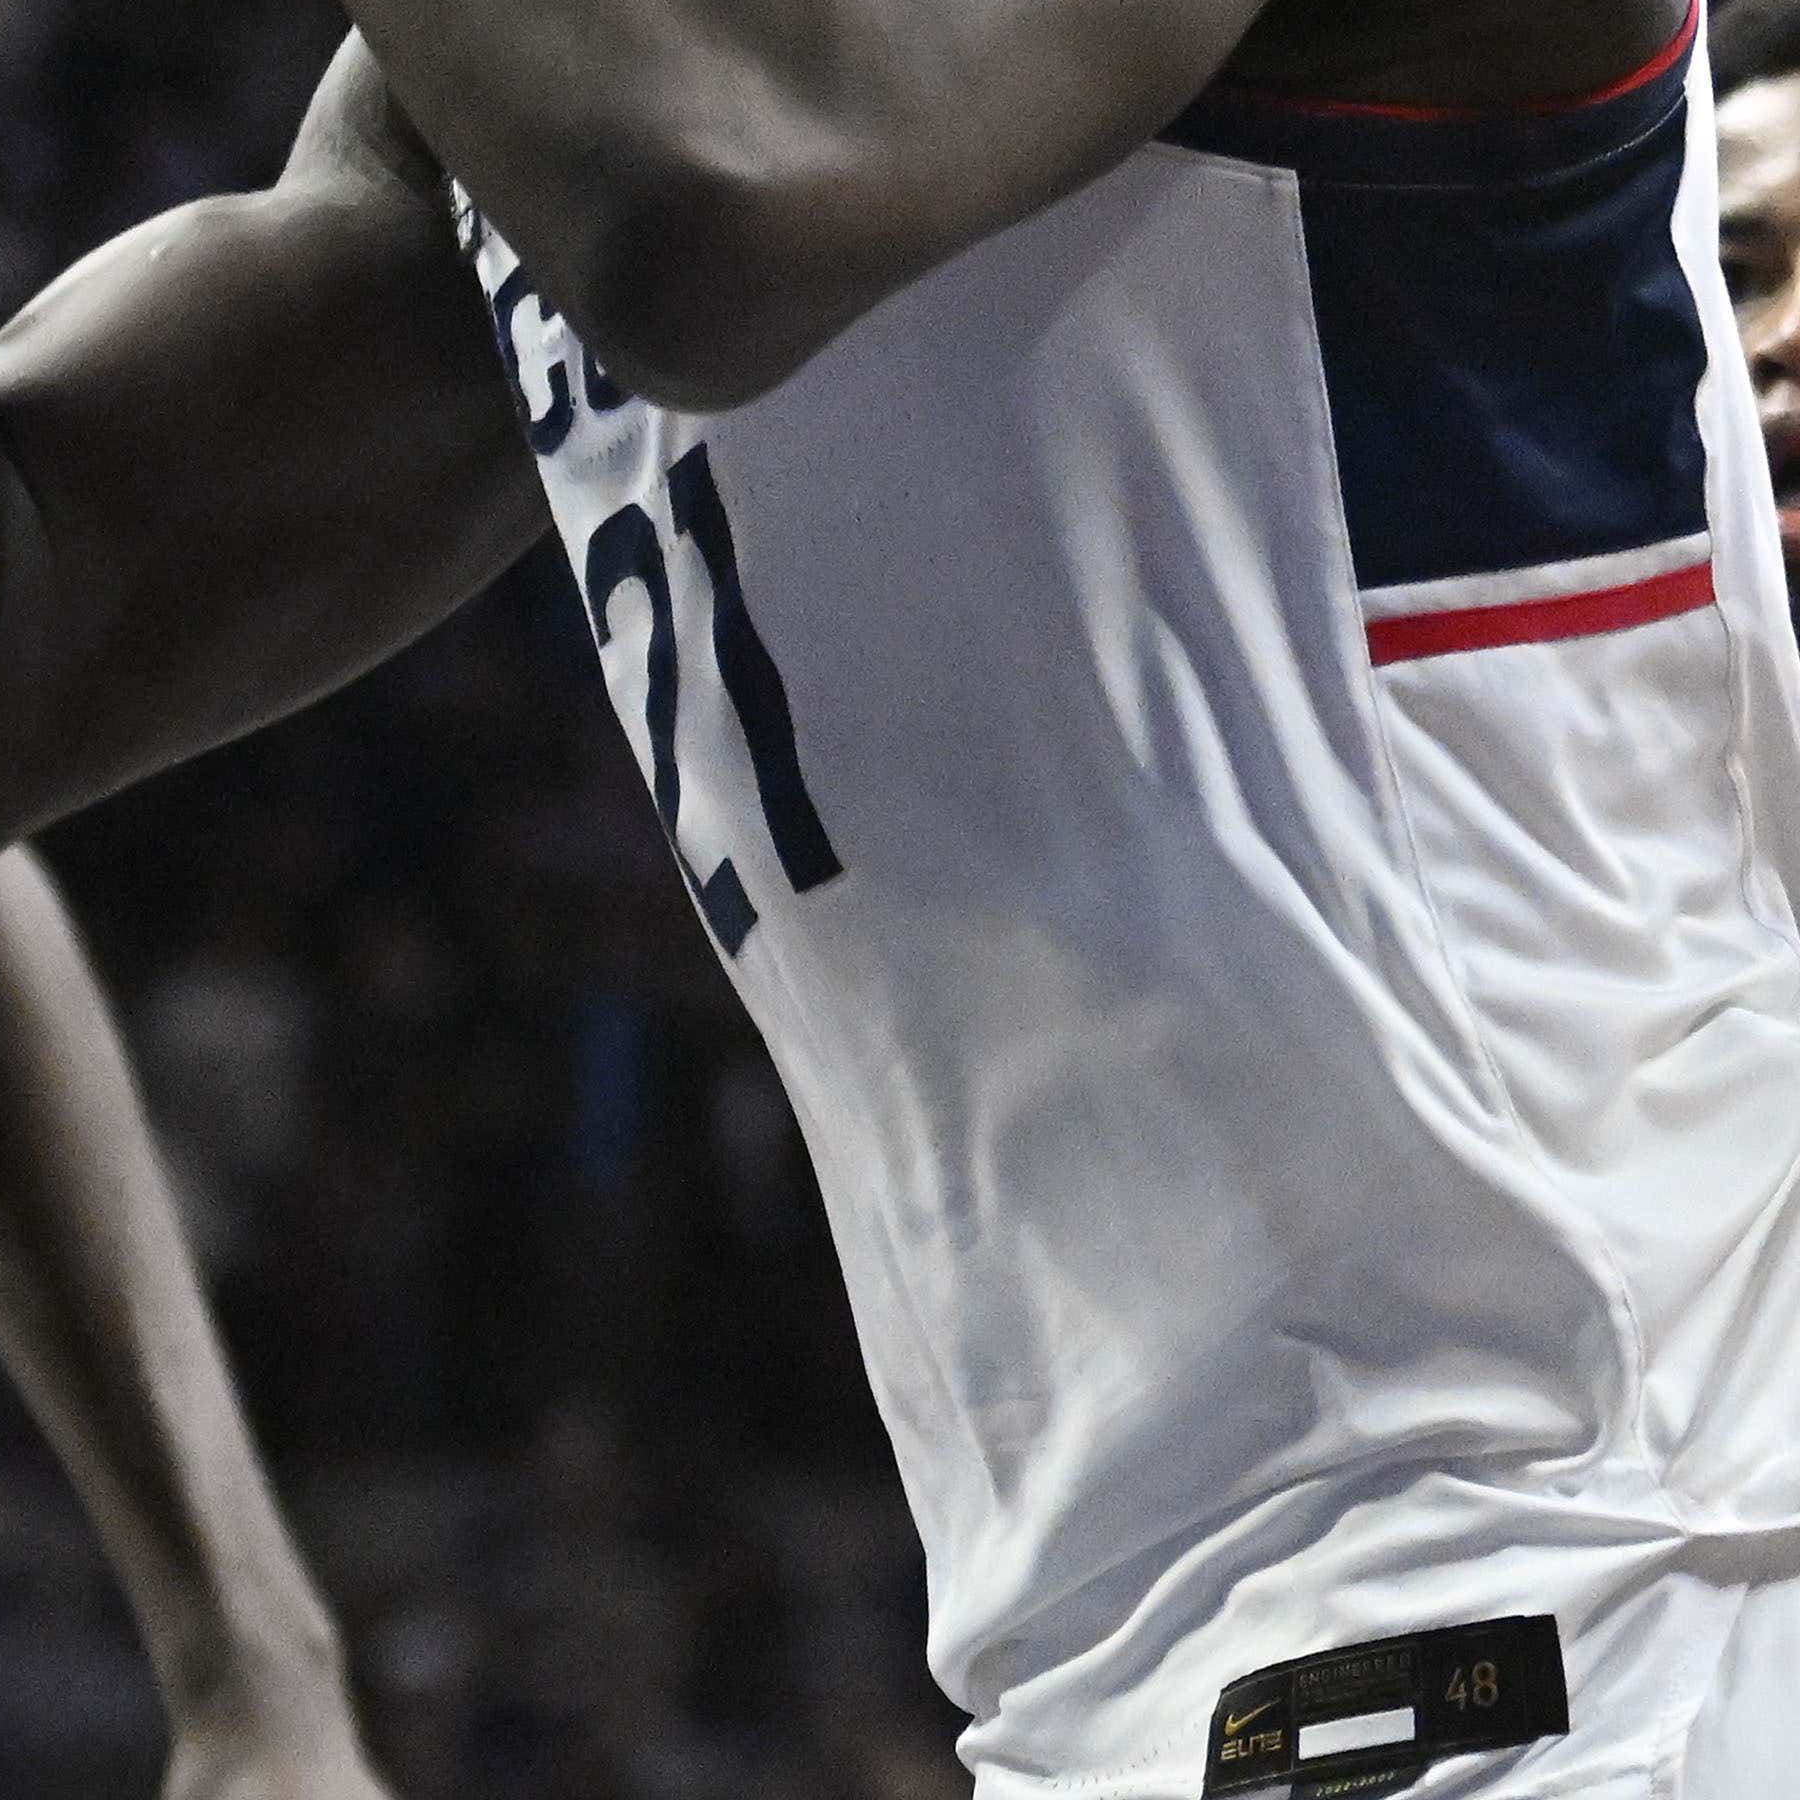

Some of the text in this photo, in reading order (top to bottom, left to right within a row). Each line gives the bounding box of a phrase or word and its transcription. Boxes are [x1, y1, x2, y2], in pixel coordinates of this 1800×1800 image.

[584, 441, 845, 958] 21
[1443, 1660, 1499, 1711] 48
[1220, 1728, 1285, 1762] ELITE
